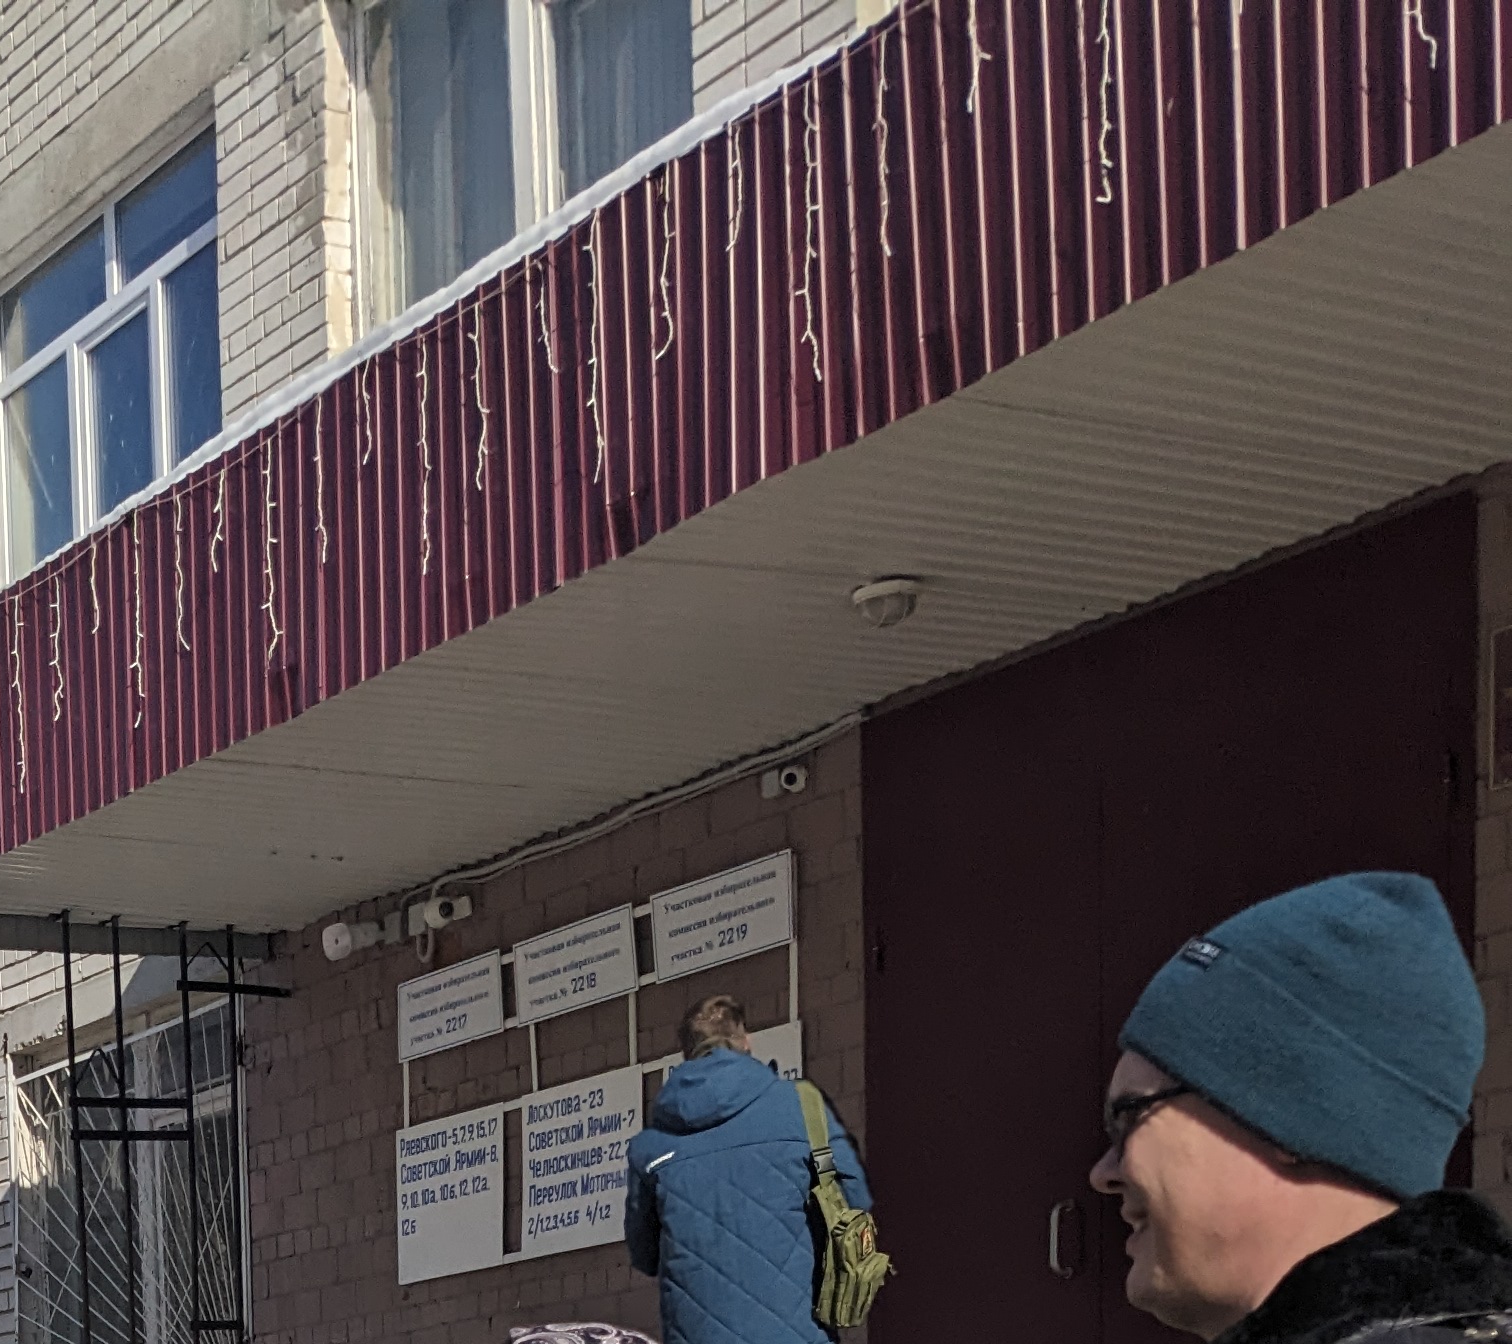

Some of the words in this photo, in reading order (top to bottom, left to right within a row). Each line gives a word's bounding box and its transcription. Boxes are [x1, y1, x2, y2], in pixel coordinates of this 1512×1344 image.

[718, 923, 748, 947] 2219
[571, 972, 597, 994] 2218
[445, 1013, 468, 1033] 2217
[528, 1120, 584, 1152] Советской
[400, 1154, 451, 1185] Советской
[528, 1179, 578, 1207] Переулок
[580, 1167, 629, 1196] Моторны
